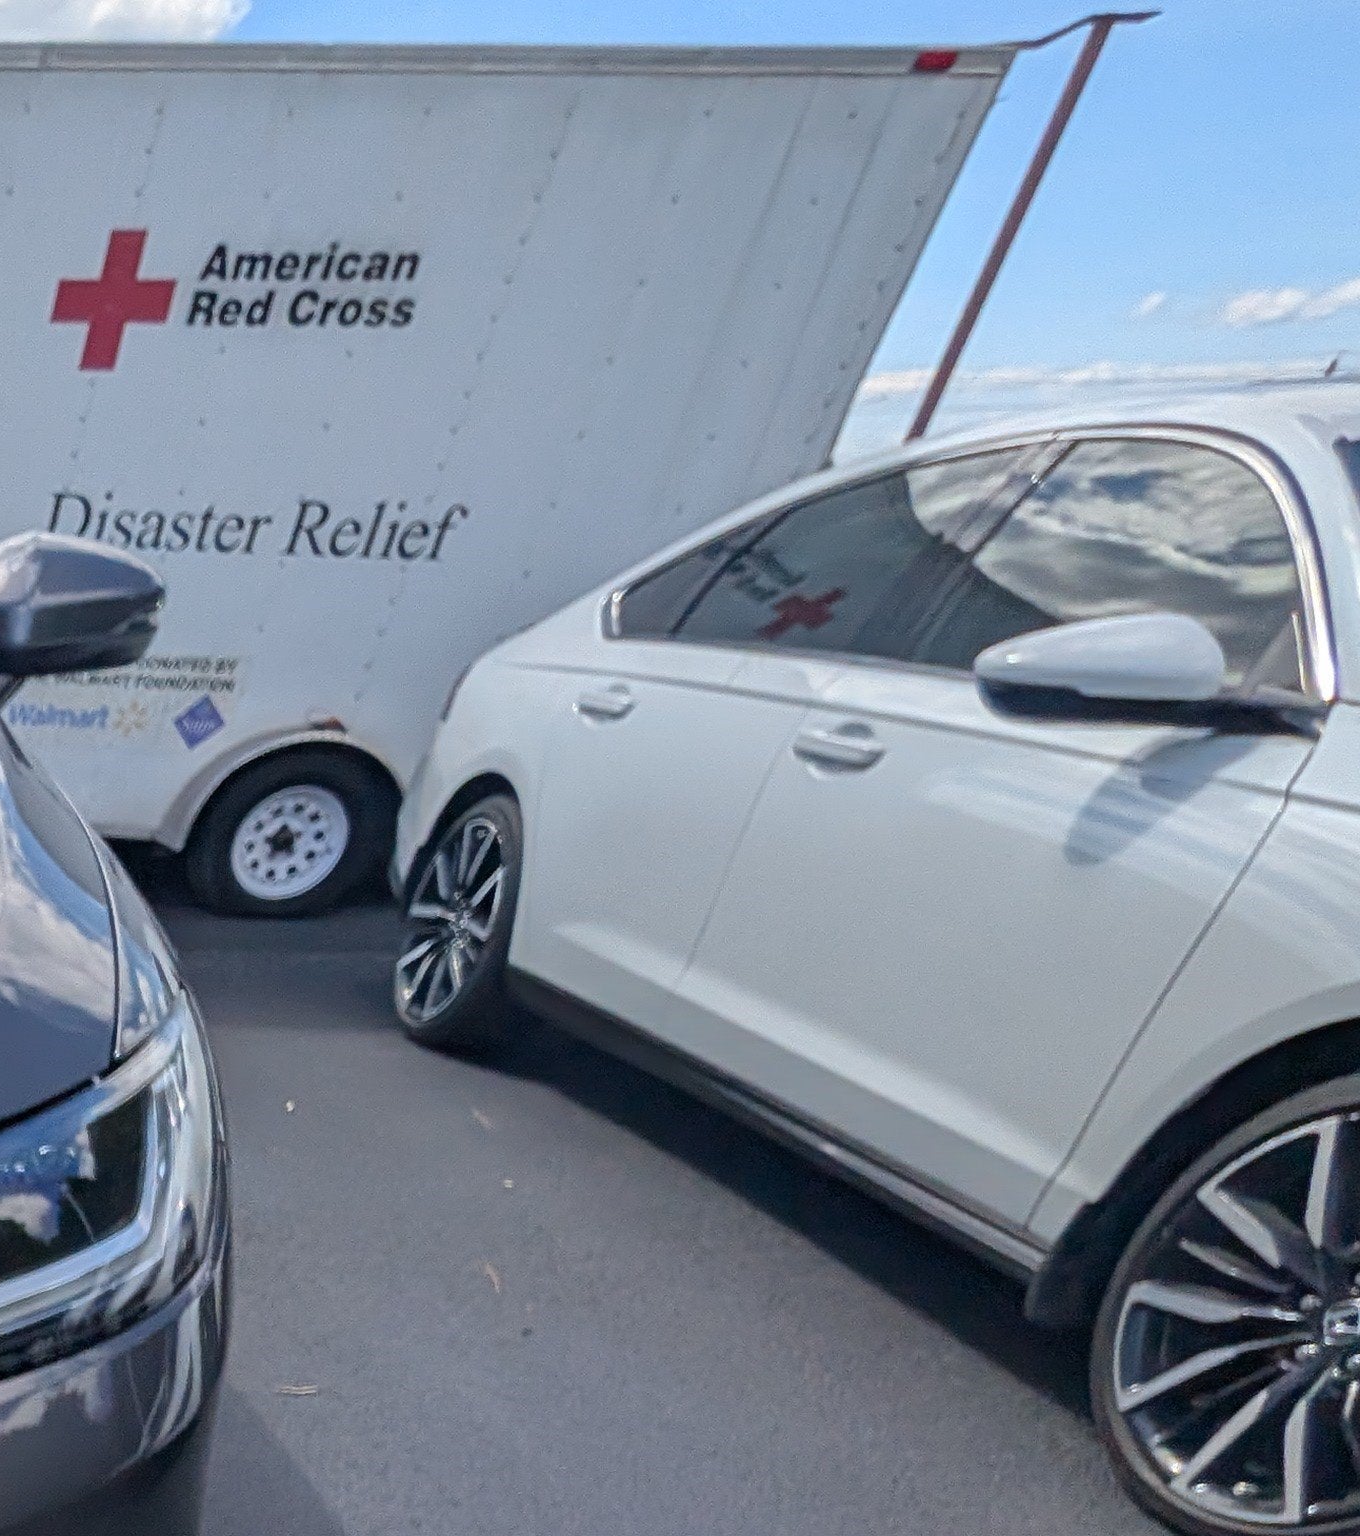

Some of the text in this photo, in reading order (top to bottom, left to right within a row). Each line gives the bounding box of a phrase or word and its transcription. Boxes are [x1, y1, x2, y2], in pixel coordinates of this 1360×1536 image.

[199, 242, 422, 283] American
[186, 290, 417, 329] Red Cross
[48, 490, 471, 561] Disaster Relief
[8, 702, 109, 729] Walmart
